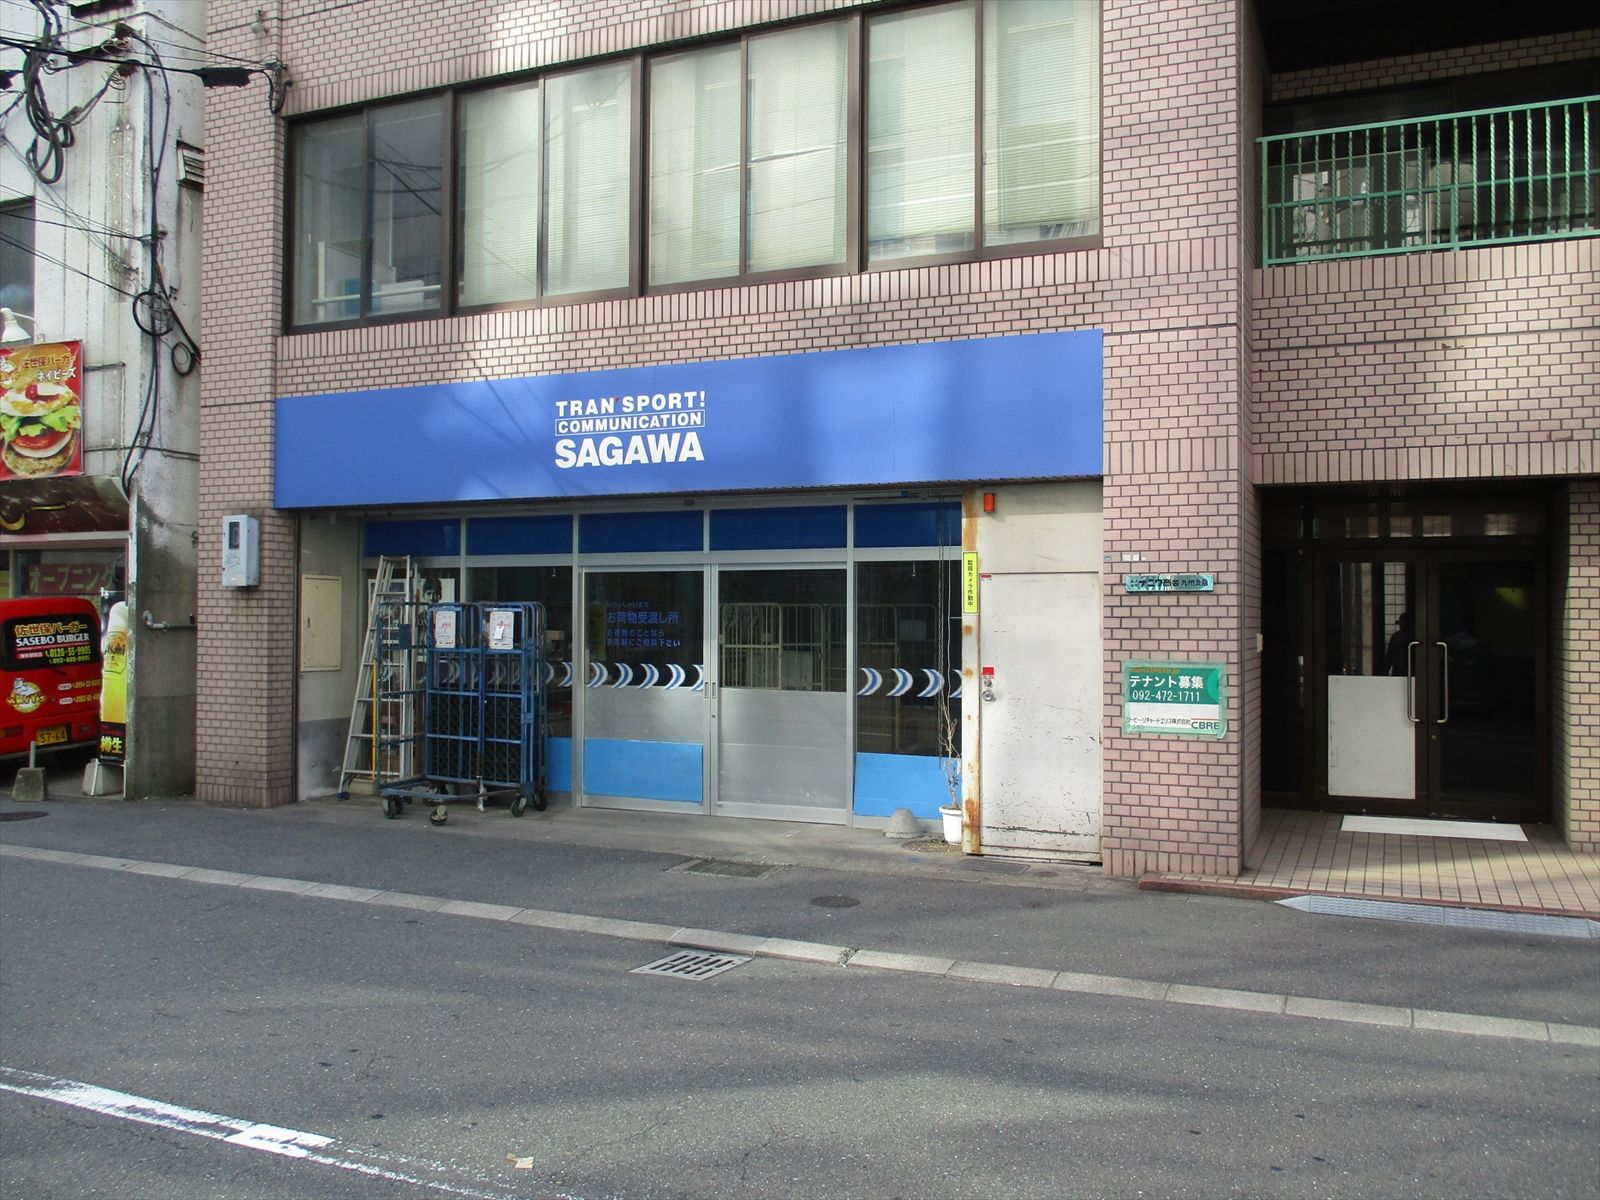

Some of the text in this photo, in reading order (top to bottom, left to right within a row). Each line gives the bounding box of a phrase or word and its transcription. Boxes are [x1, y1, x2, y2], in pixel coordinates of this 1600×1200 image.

[558, 412, 702, 433] COMMUNICATION
[555, 432, 704, 468] SAGAWA
[15, 621, 87, 637] 佐世保バーガー
[16, 633, 89, 646] SASEBO BURGER
[1130, 676, 1203, 689] テナント募集
[1132, 690, 1200, 701] 092-472-1711
[1191, 721, 1220, 730] CBRE
